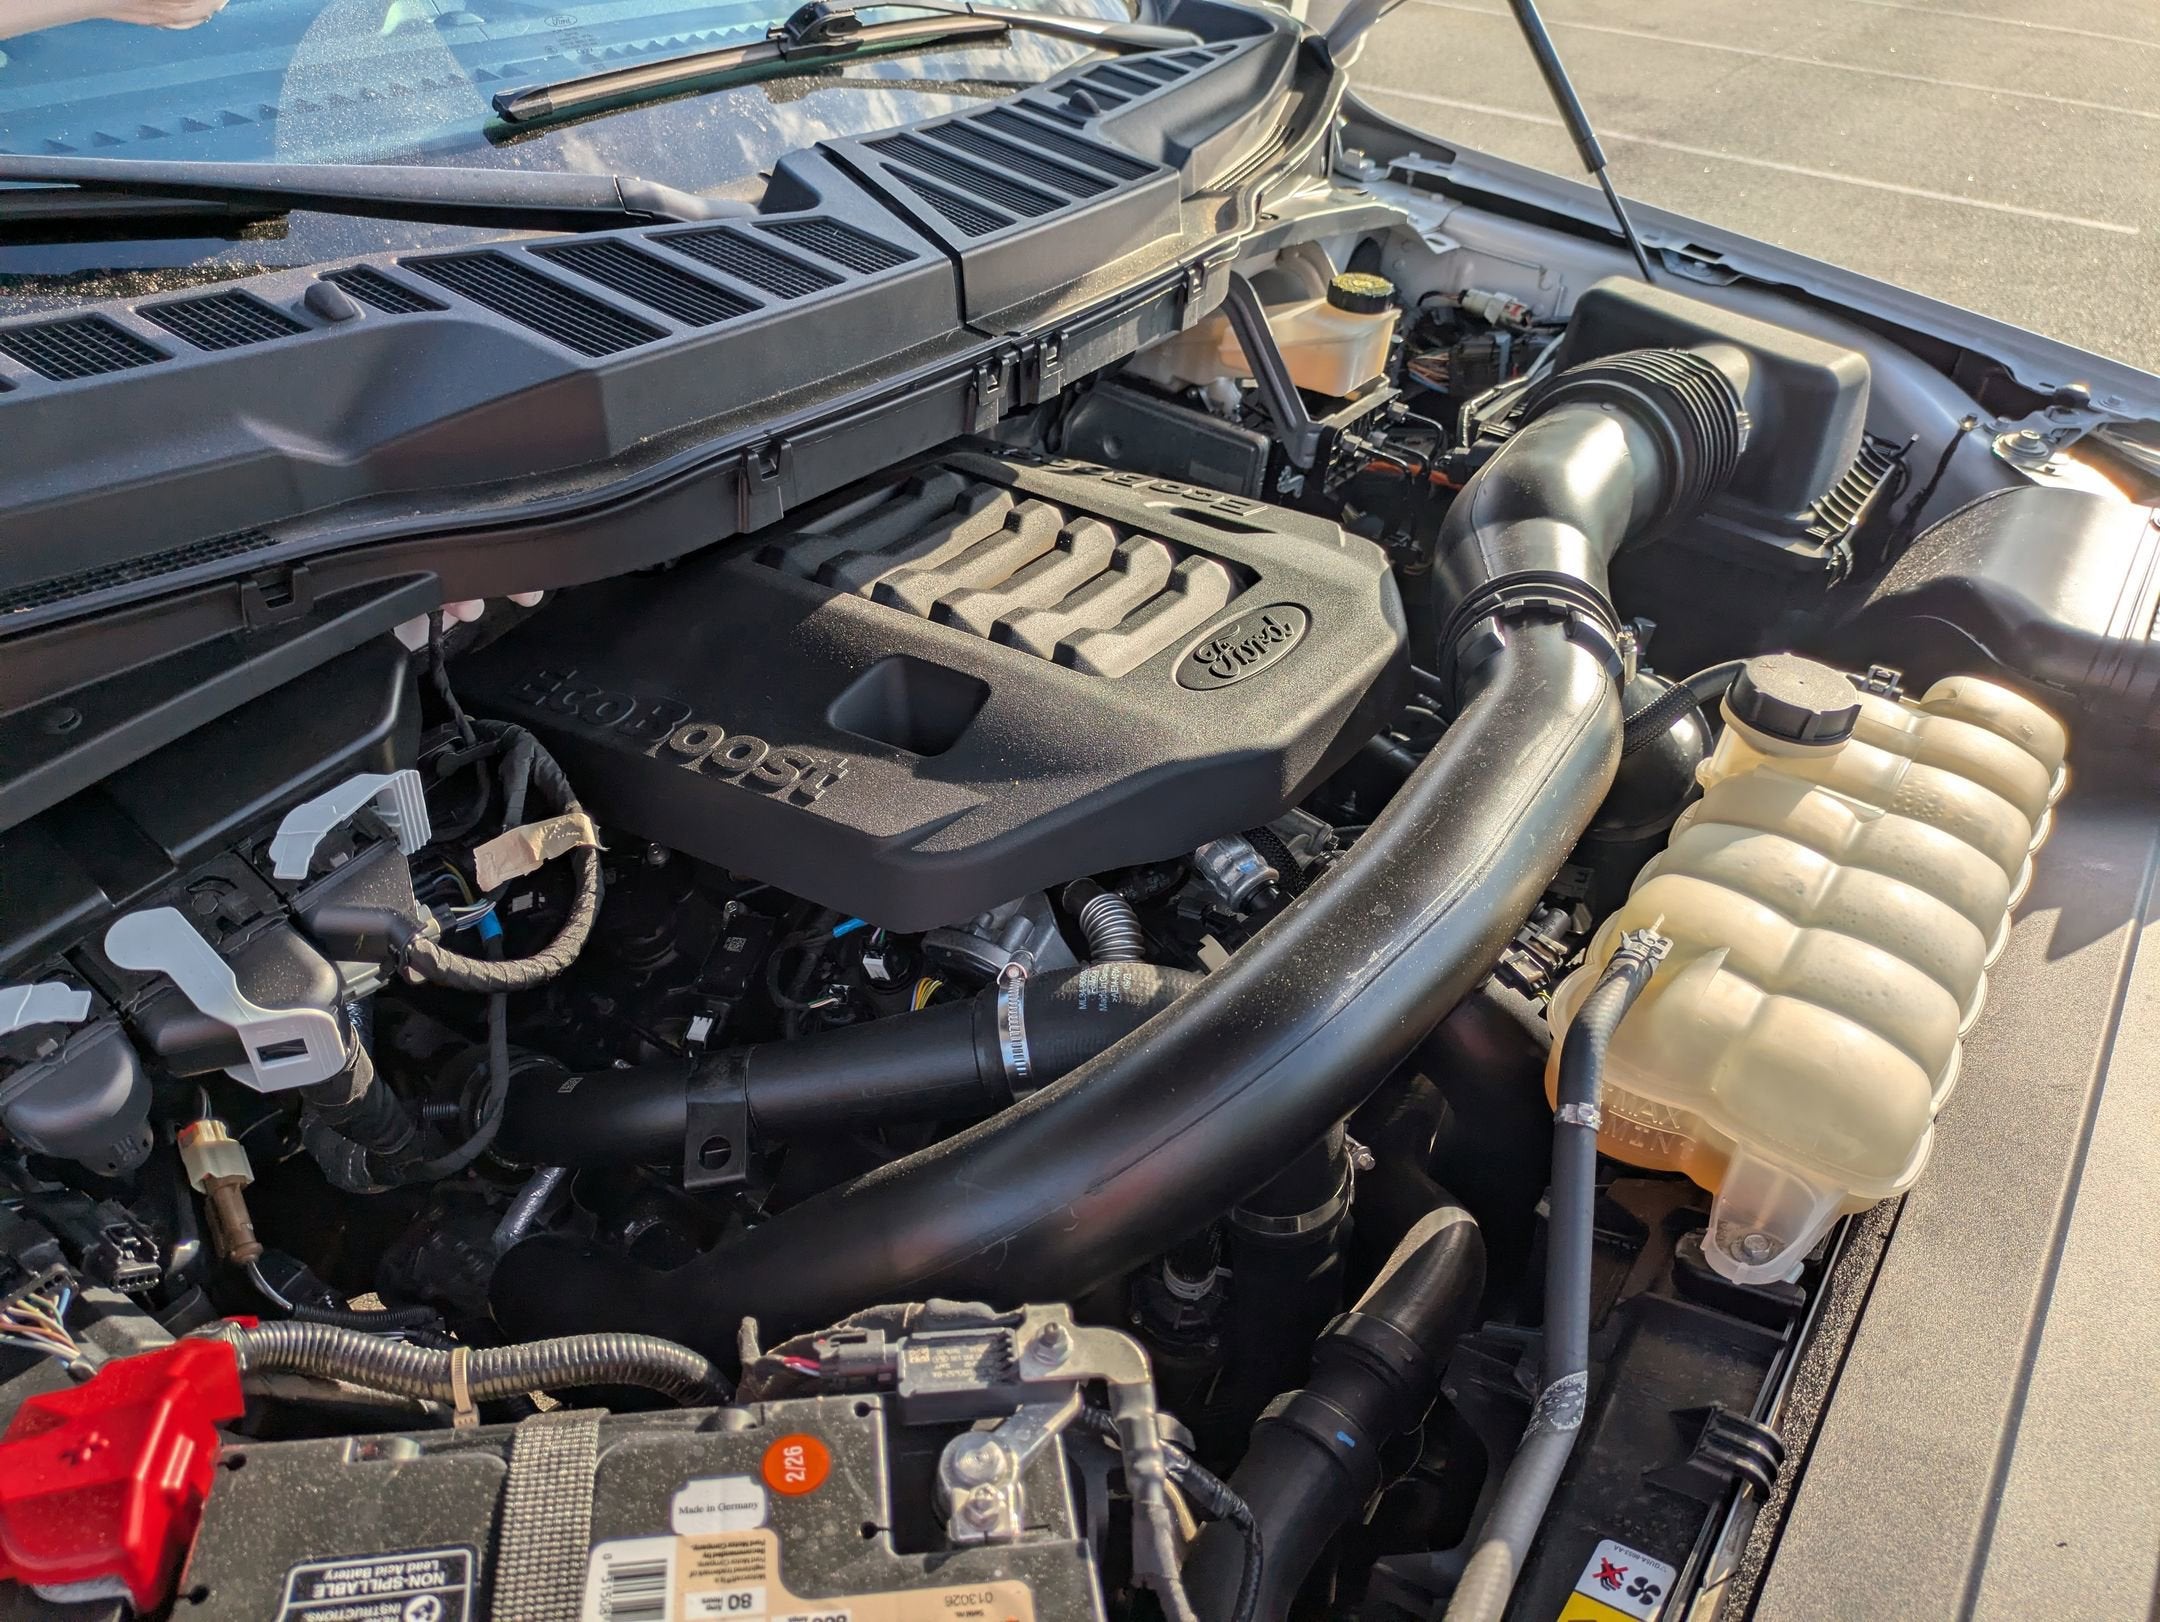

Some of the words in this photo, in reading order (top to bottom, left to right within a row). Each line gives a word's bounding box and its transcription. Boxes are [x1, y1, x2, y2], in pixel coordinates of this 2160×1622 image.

[1194, 615, 1295, 679] Ford
[784, 1446, 806, 1482] 2/26
[679, 1505, 704, 1515] Made
[706, 1503, 716, 1512] in
[718, 1501, 759, 1513] Germany
[323, 1567, 372, 1580] Battery
[375, 1564, 404, 1577] Acid
[406, 1560, 439, 1574] Lead
[312, 1572, 445, 1599] NON-SPILLABLE
[728, 1593, 752, 1610] 80
